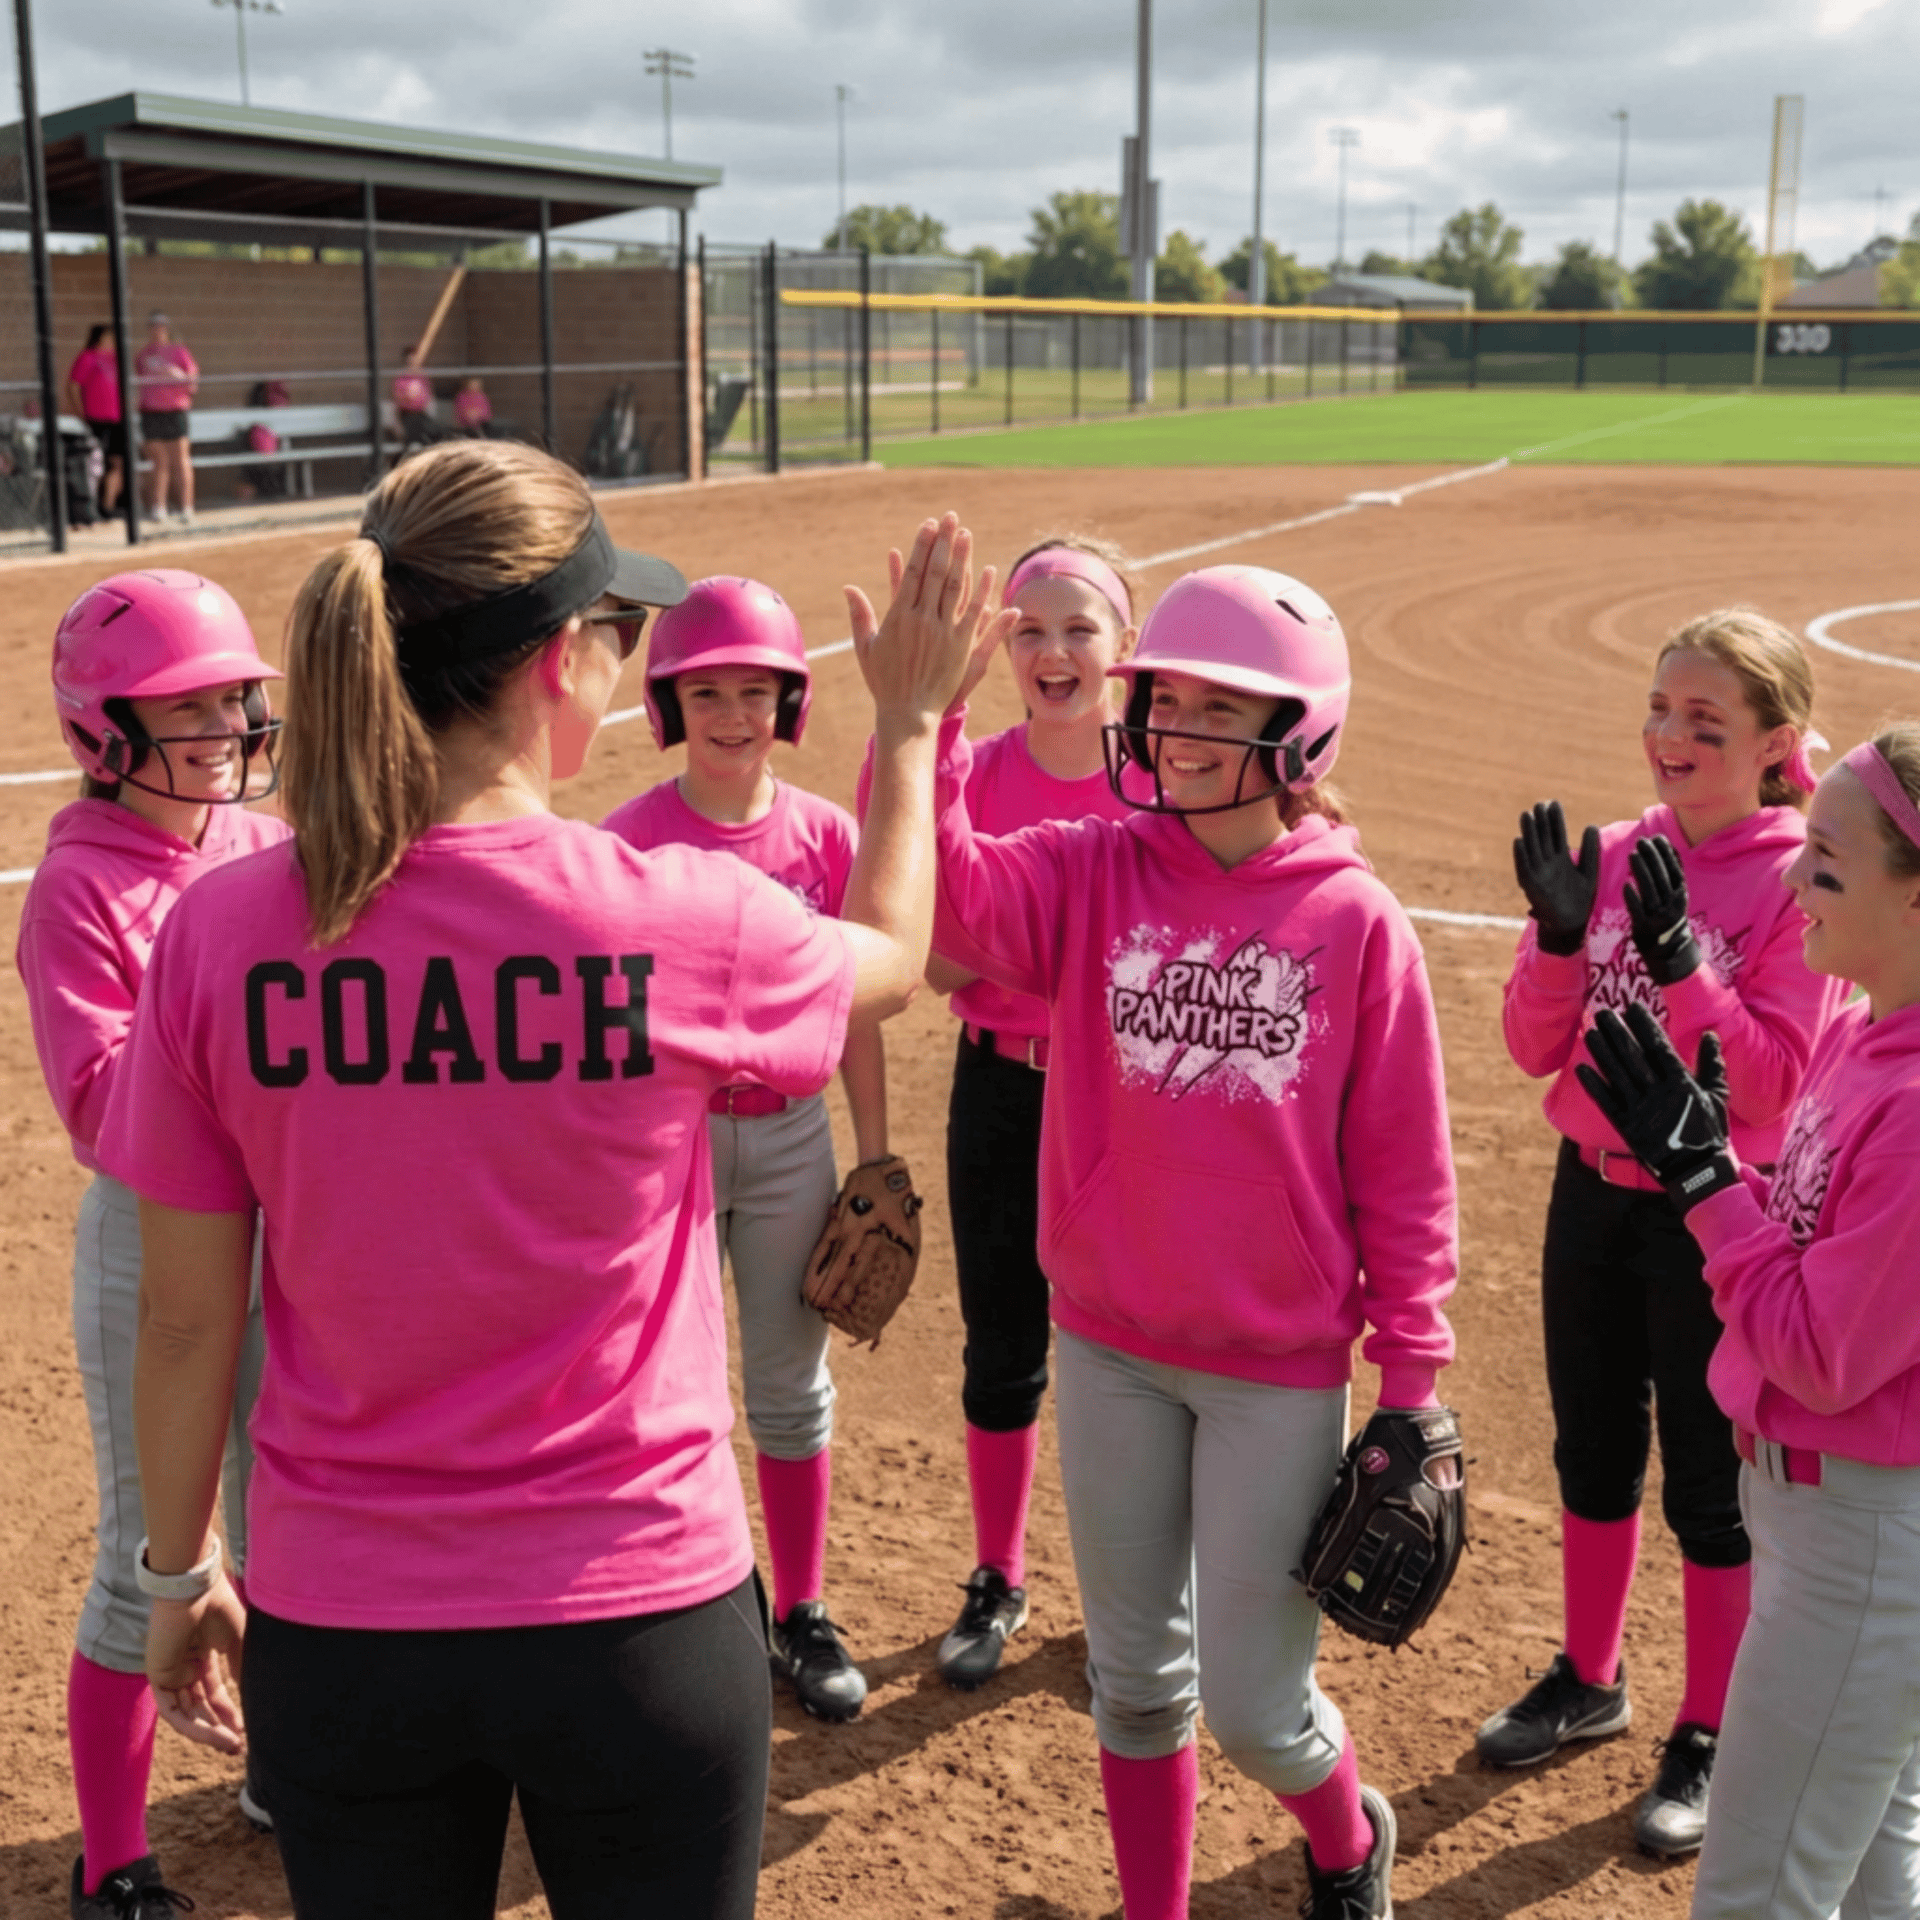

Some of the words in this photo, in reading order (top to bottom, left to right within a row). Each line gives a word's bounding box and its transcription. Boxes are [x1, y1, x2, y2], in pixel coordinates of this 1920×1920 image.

[1162, 963, 1260, 1008] PINK
[246, 954, 655, 1088] COACH
[1115, 989, 1299, 1057] PANTHERS
